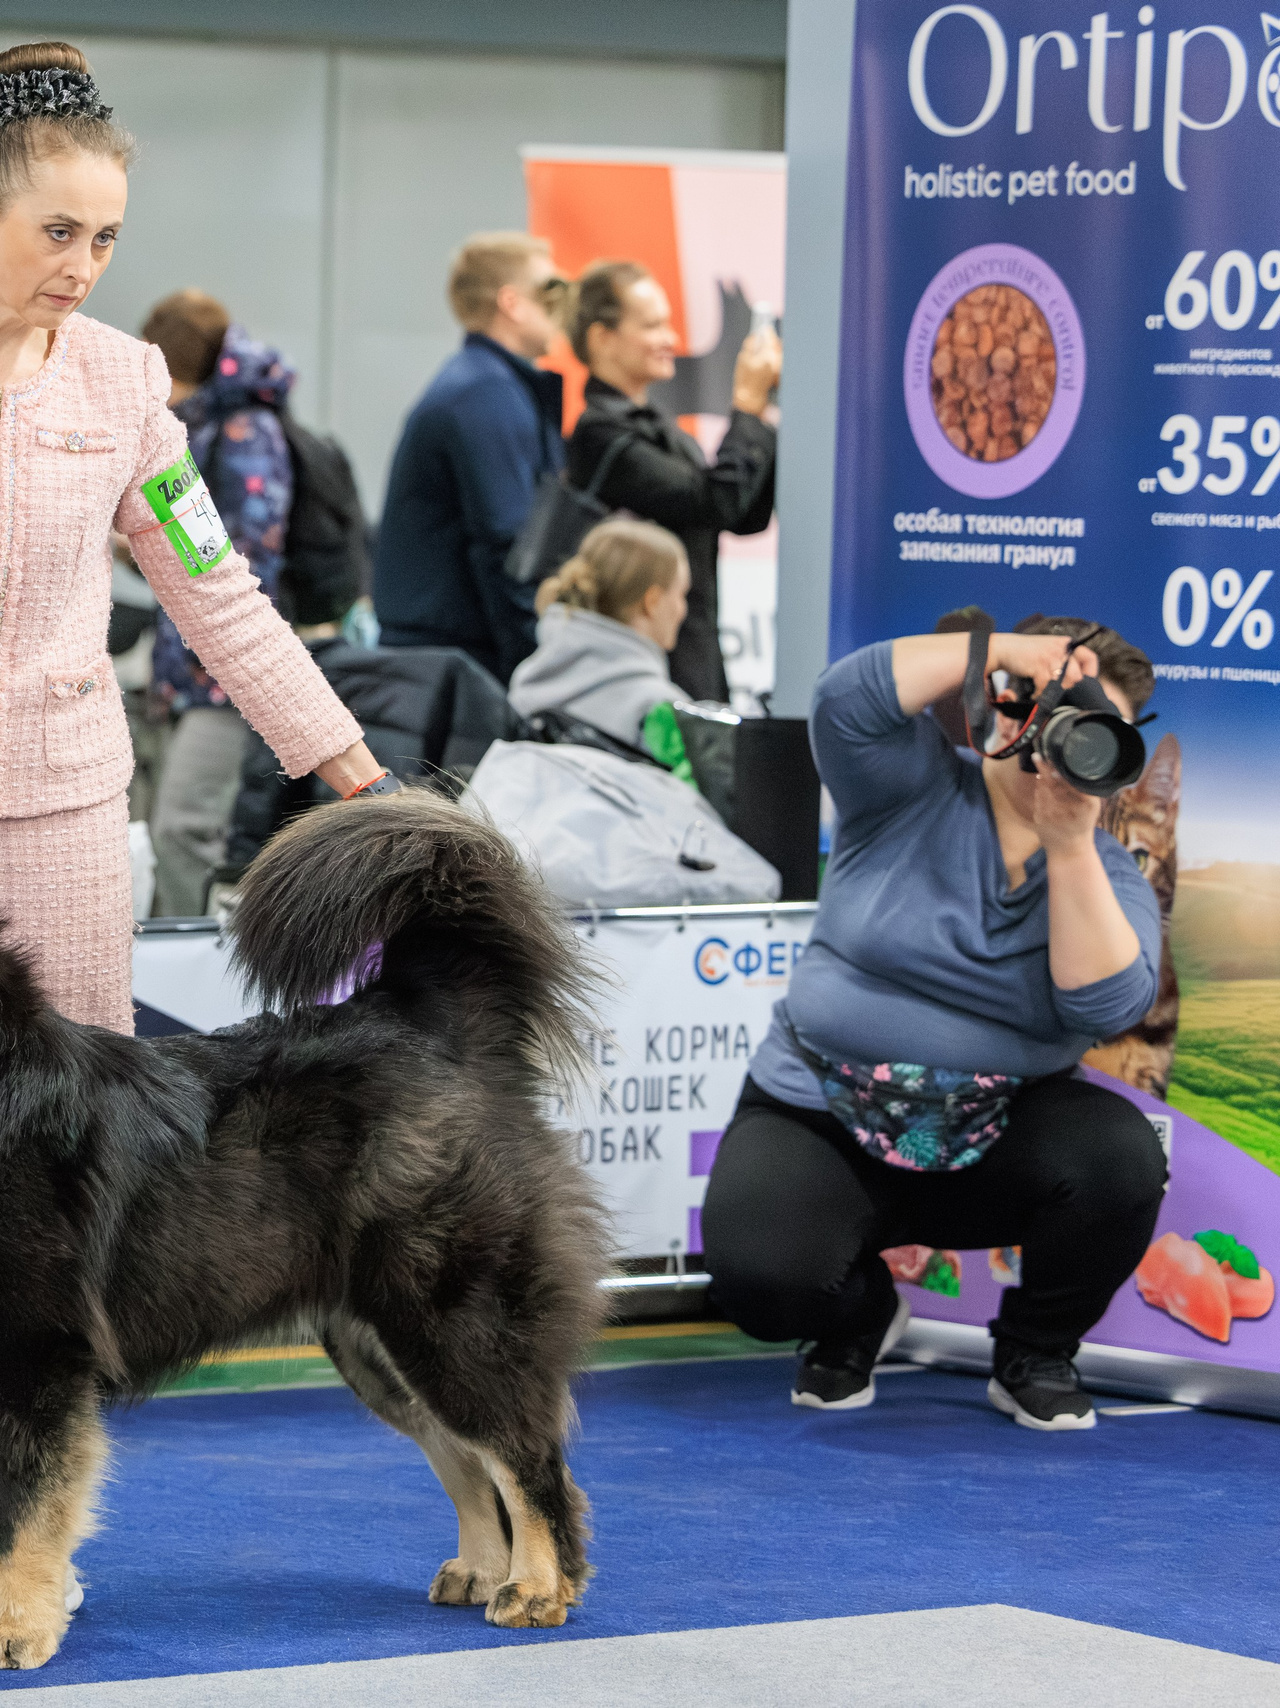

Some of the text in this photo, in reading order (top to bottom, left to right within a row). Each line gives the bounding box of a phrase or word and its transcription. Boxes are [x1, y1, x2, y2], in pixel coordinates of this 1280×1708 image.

[907, 4, 1280, 192] Ortip
[904, 160, 1137, 205] holistic pet food
[1138, 477, 1158, 493] от
[893, 506, 1085, 538] особая технология
[1151, 511, 1207, 528] свежего
[1209, 513, 1243, 529] мяса
[1244, 514, 1256, 529] и
[899, 540, 1077, 571] запекания гранул
[1162, 566, 1274, 650] 0%
[1210, 666, 1220, 680] и
[645, 1023, 751, 1064] КОРМА
[600, 1073, 707, 1115] КОШЕК
